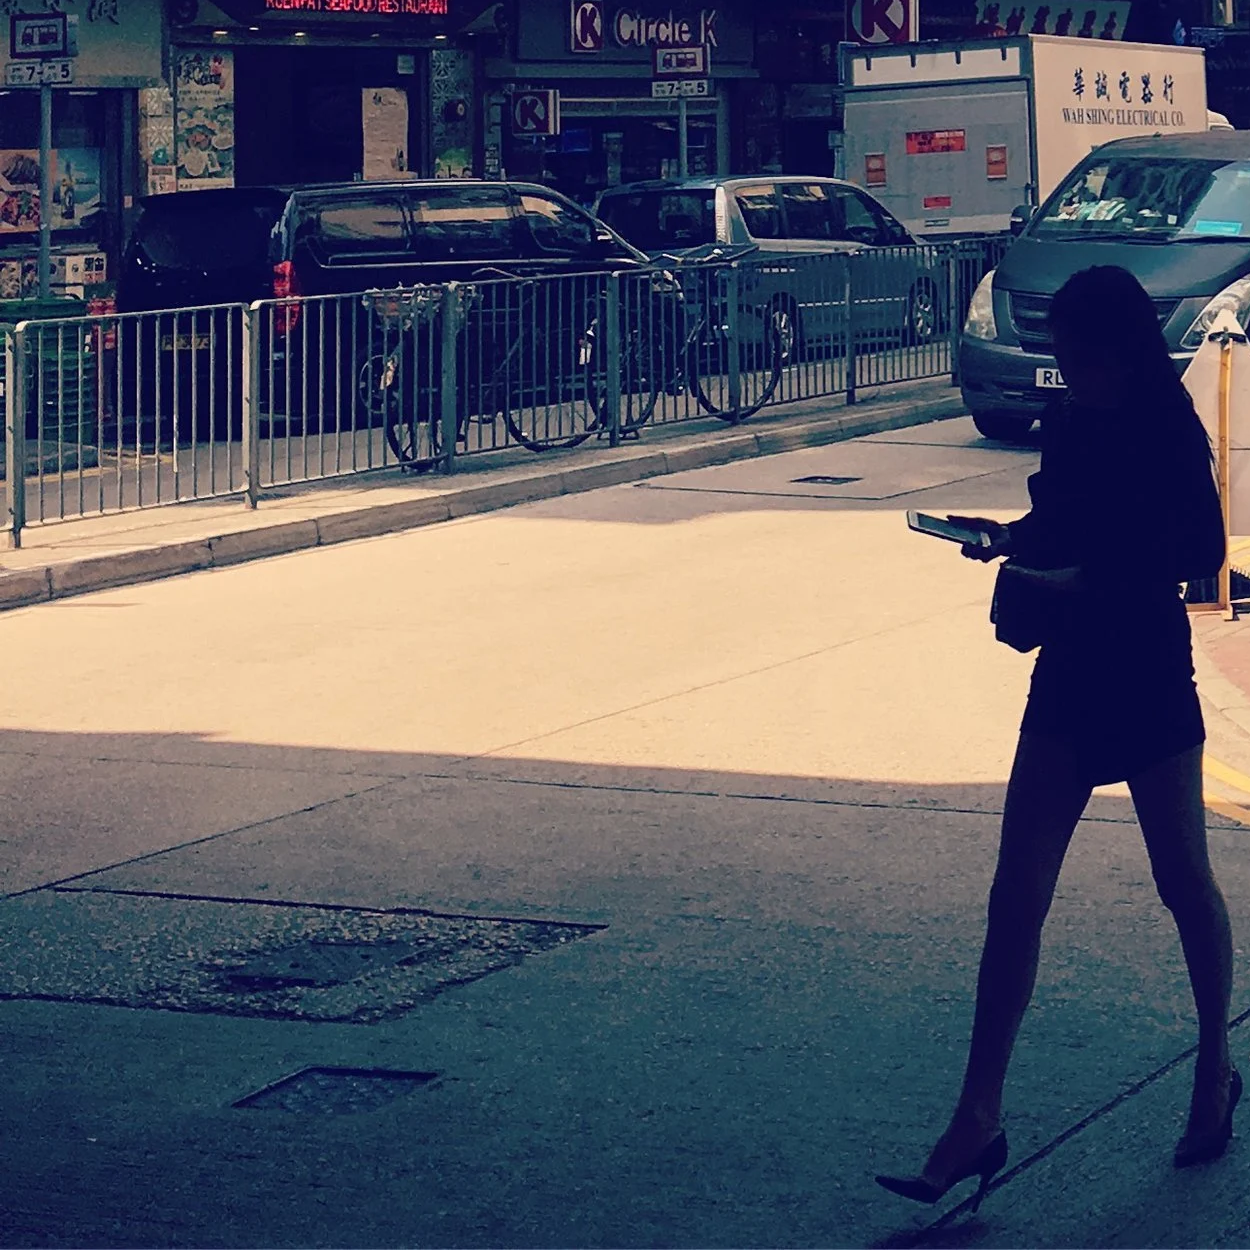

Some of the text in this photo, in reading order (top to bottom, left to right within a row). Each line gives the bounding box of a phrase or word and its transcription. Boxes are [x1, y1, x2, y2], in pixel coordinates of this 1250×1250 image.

[613, 7, 718, 47] Circle K
[1062, 107, 1084, 125] WAH
[1086, 108, 1115, 125] SHING
[1116, 109, 1170, 126] ELECTRICAL
